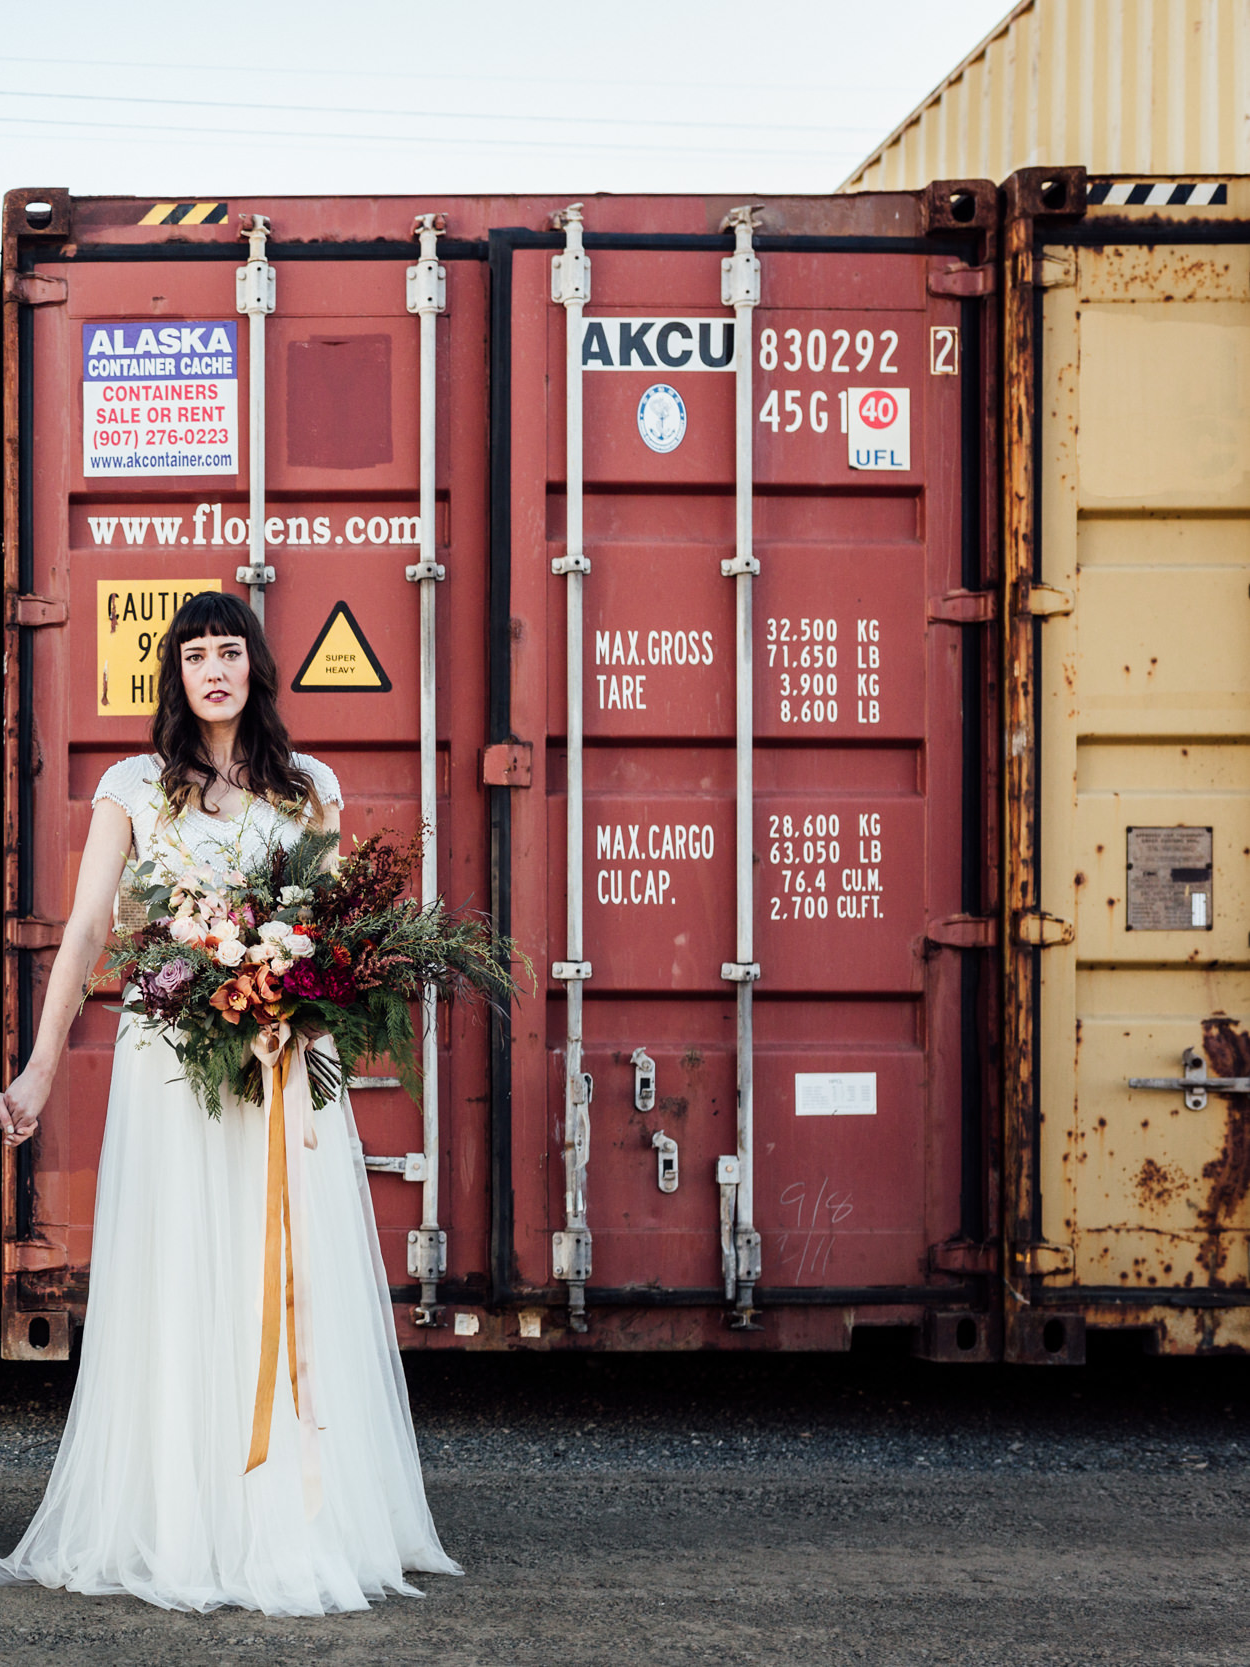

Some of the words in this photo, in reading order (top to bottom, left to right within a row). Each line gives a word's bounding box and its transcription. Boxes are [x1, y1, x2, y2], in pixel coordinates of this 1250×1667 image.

[88, 327, 233, 356] ALASKA
[582, 321, 735, 368] AKCU
[758, 328, 898, 373] 830292
[935, 330, 954, 372] 2
[88, 358, 176, 377] CONTAINER
[180, 356, 233, 375] CACHE
[103, 384, 219, 402] CONTAINERS
[96, 408, 141, 425] SALE
[147, 407, 172, 423] OR
[177, 406, 226, 423] RENT
[759, 389, 848, 434] 45G1
[861, 396, 894, 424] 40
[93, 430, 139, 450] (907)
[145, 429, 229, 446] 276-0223
[90, 451, 232, 469] www.akcontainer.com
[856, 449, 903, 467] UFL
[87, 503, 421, 545] www.floens.com
[766, 618, 837, 643] 32,500
[857, 619, 880, 643] KG
[325, 654, 356, 662] SUPER
[595, 630, 714, 666] MAX.GROSS
[767, 645, 837, 669] 71,650
[857, 646, 880, 669] LB
[325, 666, 356, 674] HEAVY
[596, 675, 647, 710] TARE
[780, 673, 838, 697] 3,900
[857, 674, 880, 697] KG
[780, 700, 838, 724] 8,600
[857, 700, 880, 724] LB
[768, 815, 840, 838] 28,600
[858, 814, 881, 837] KG
[596, 825, 715, 860] MAX.CARGO
[769, 841, 840, 864] 63,050
[859, 840, 882, 863] LB
[597, 870, 676, 905] CU.CAP.
[781, 869, 826, 893] 76.4
[841, 868, 884, 892] CU.M.
[770, 896, 828, 920] 2,700
[836, 895, 884, 919] CU.FT.
